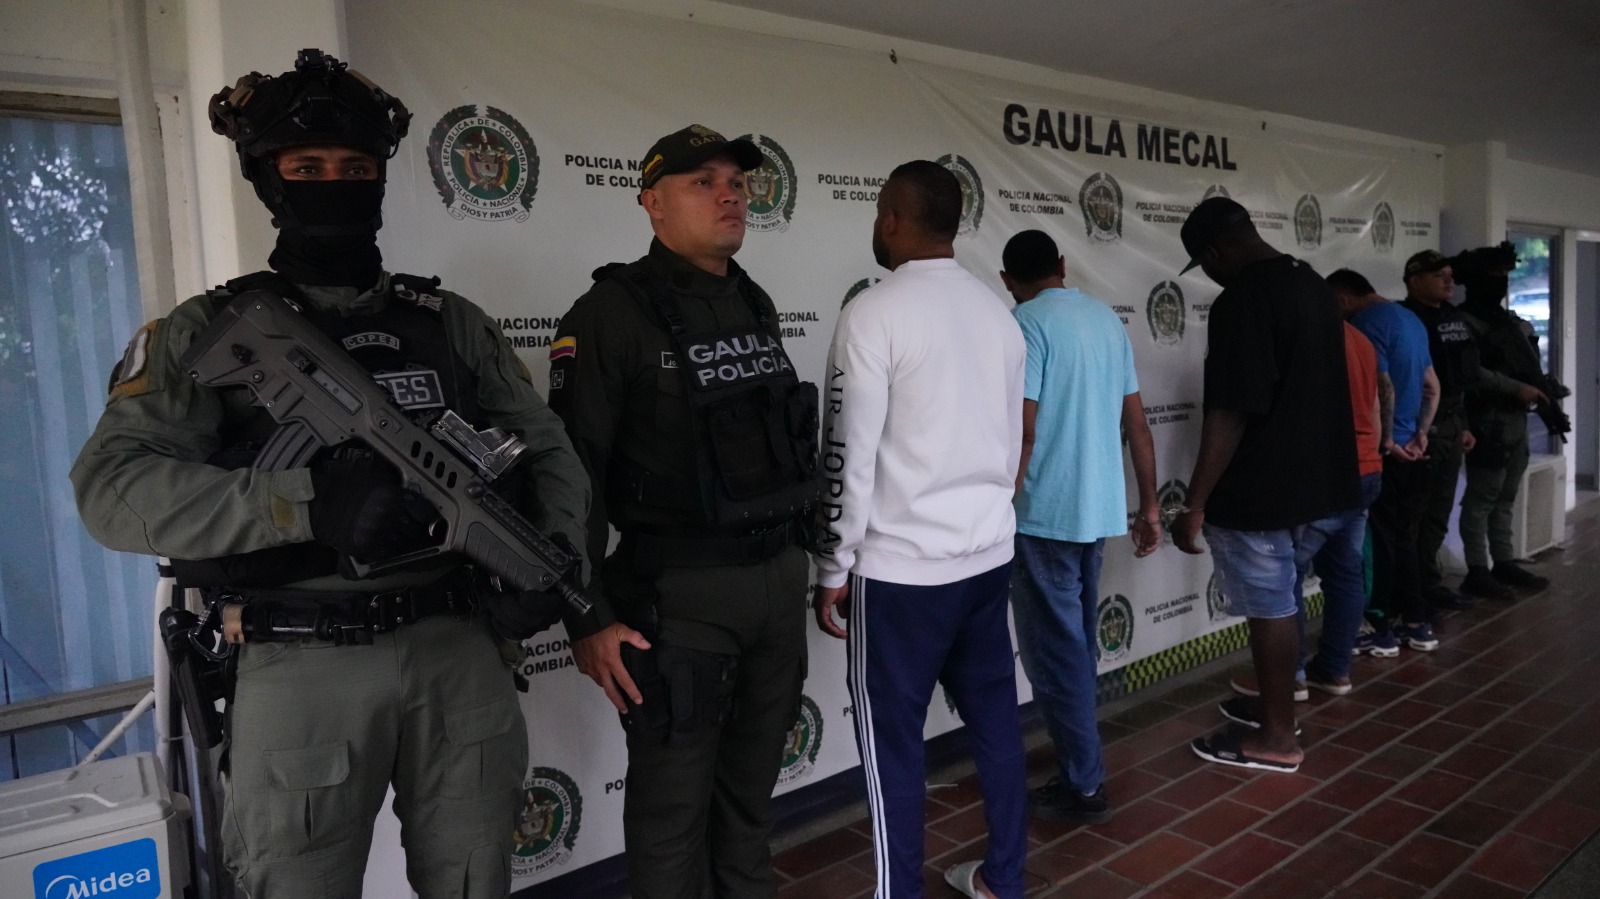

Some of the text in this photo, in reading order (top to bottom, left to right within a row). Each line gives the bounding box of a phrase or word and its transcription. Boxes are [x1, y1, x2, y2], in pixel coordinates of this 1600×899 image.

[1003, 103, 1237, 171] GAULA MECAL
[443, 118, 527, 173] REPUBLICA DE COLOMBIA
[565, 154, 623, 170] POLICIA
[768, 150, 788, 190] COLOMBIA
[586, 174, 644, 188] DE COLO
[818, 174, 860, 186] POLICIA
[449, 178, 525, 208] POLICIA NACIONAL
[833, 190, 877, 201] DE COLO
[999, 189, 1072, 203] POLICIA NACIONAL
[460, 204, 482, 216] DIOS
[490, 206, 518, 219] PATRIA
[1010, 203, 1064, 215] DE COLOMBIA
[761, 219, 781, 229] PATRIA
[1112, 305, 1135, 313] CIONAL
[497, 317, 561, 330] ACIONA
[778, 312, 819, 322] CIONAL
[346, 334, 398, 347] COPES
[506, 336, 552, 348] OMBIA
[688, 333, 783, 364] GAULA
[830, 363, 846, 415] AIR
[1143, 402, 1196, 415] OLICIA NACIONAL
[1159, 413, 1189, 424] COLOMBIA
[1145, 593, 1200, 615] POLICIA NACIONAL
[1153, 605, 1193, 623] DE COLOMBIA
[522, 655, 575, 676] OMBIA
[544, 780, 570, 817] COLOMBIA
[535, 827, 567, 861] NACIONAL
[535, 852, 561, 871] PATRIA
[66, 867, 151, 899] Midea
